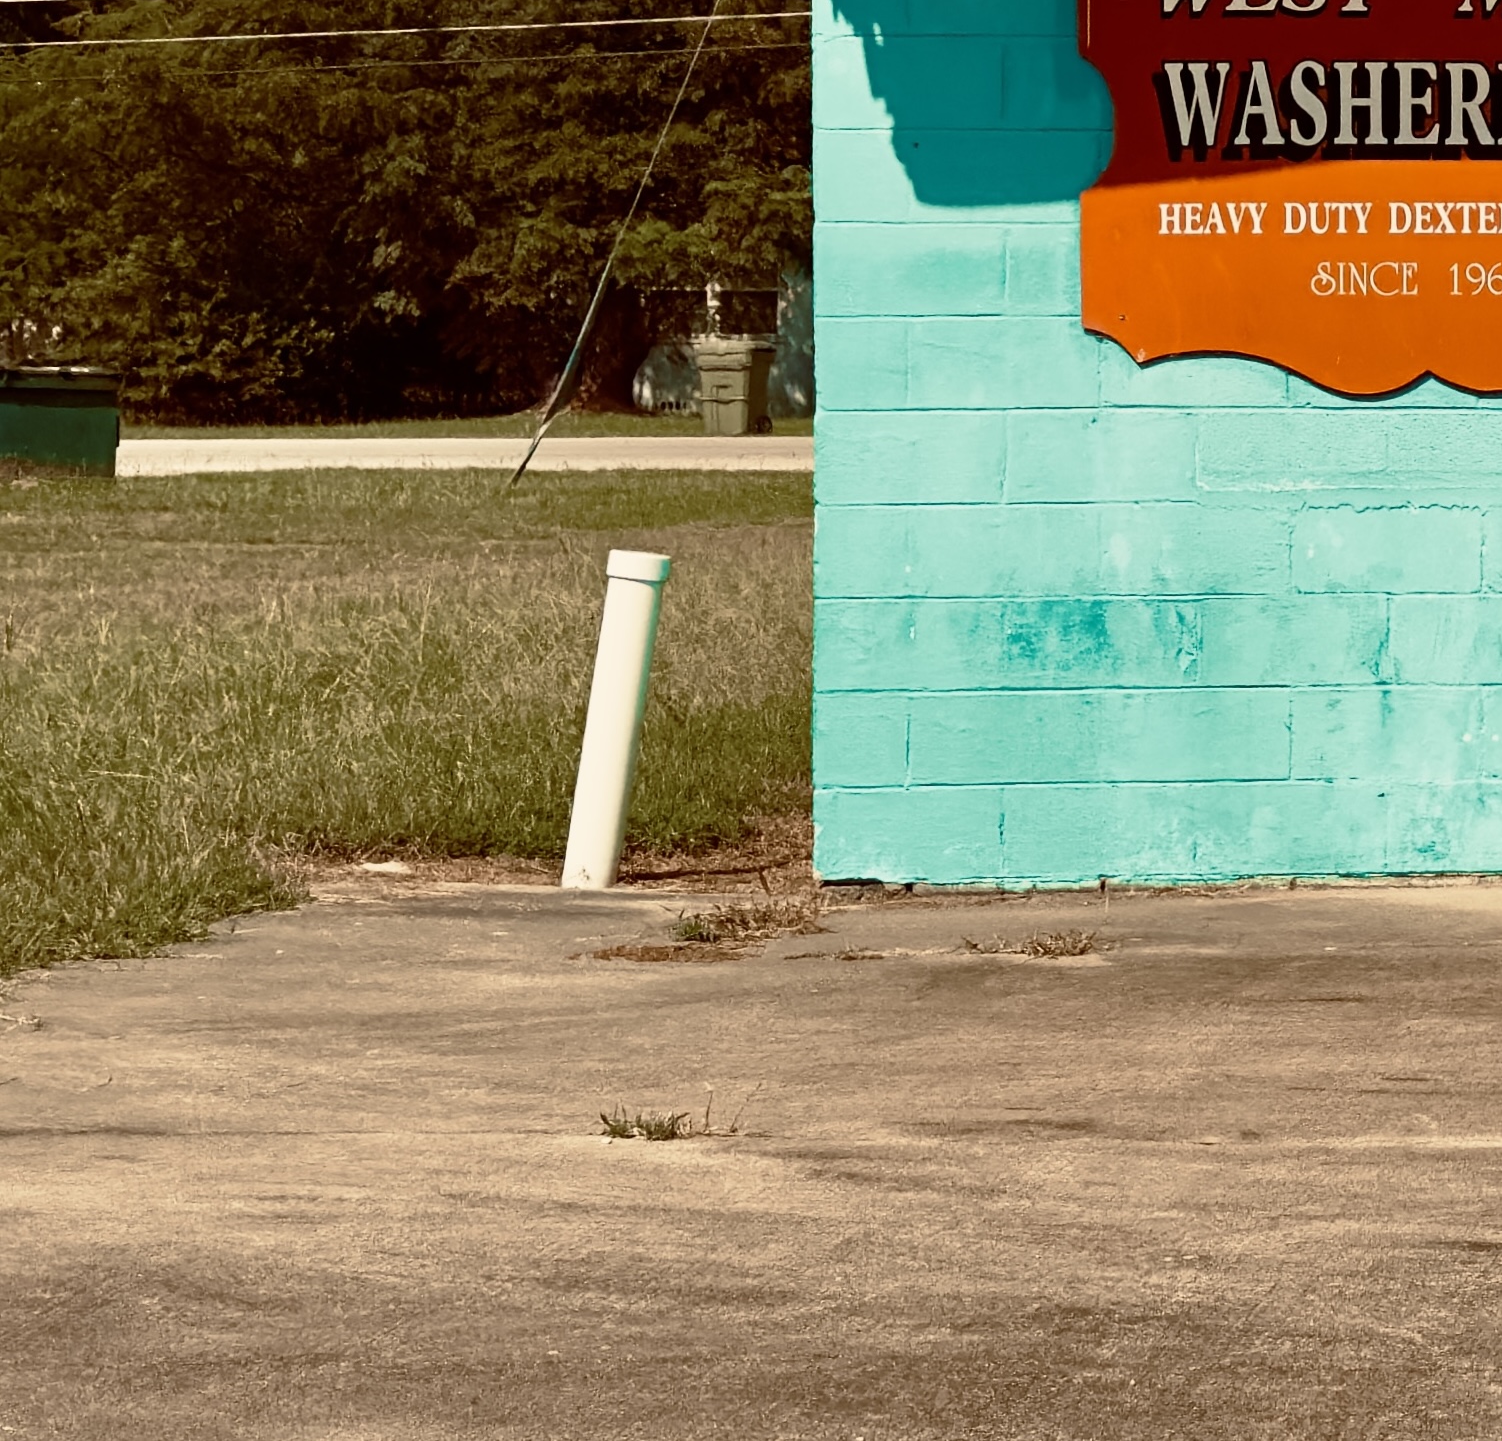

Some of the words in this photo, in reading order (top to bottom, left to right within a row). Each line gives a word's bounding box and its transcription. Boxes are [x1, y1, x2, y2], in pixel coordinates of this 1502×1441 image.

[1158, 202, 1268, 235] HEAVY
[1283, 202, 1373, 235] DUTY
[1310, 261, 1418, 296] SINCE
